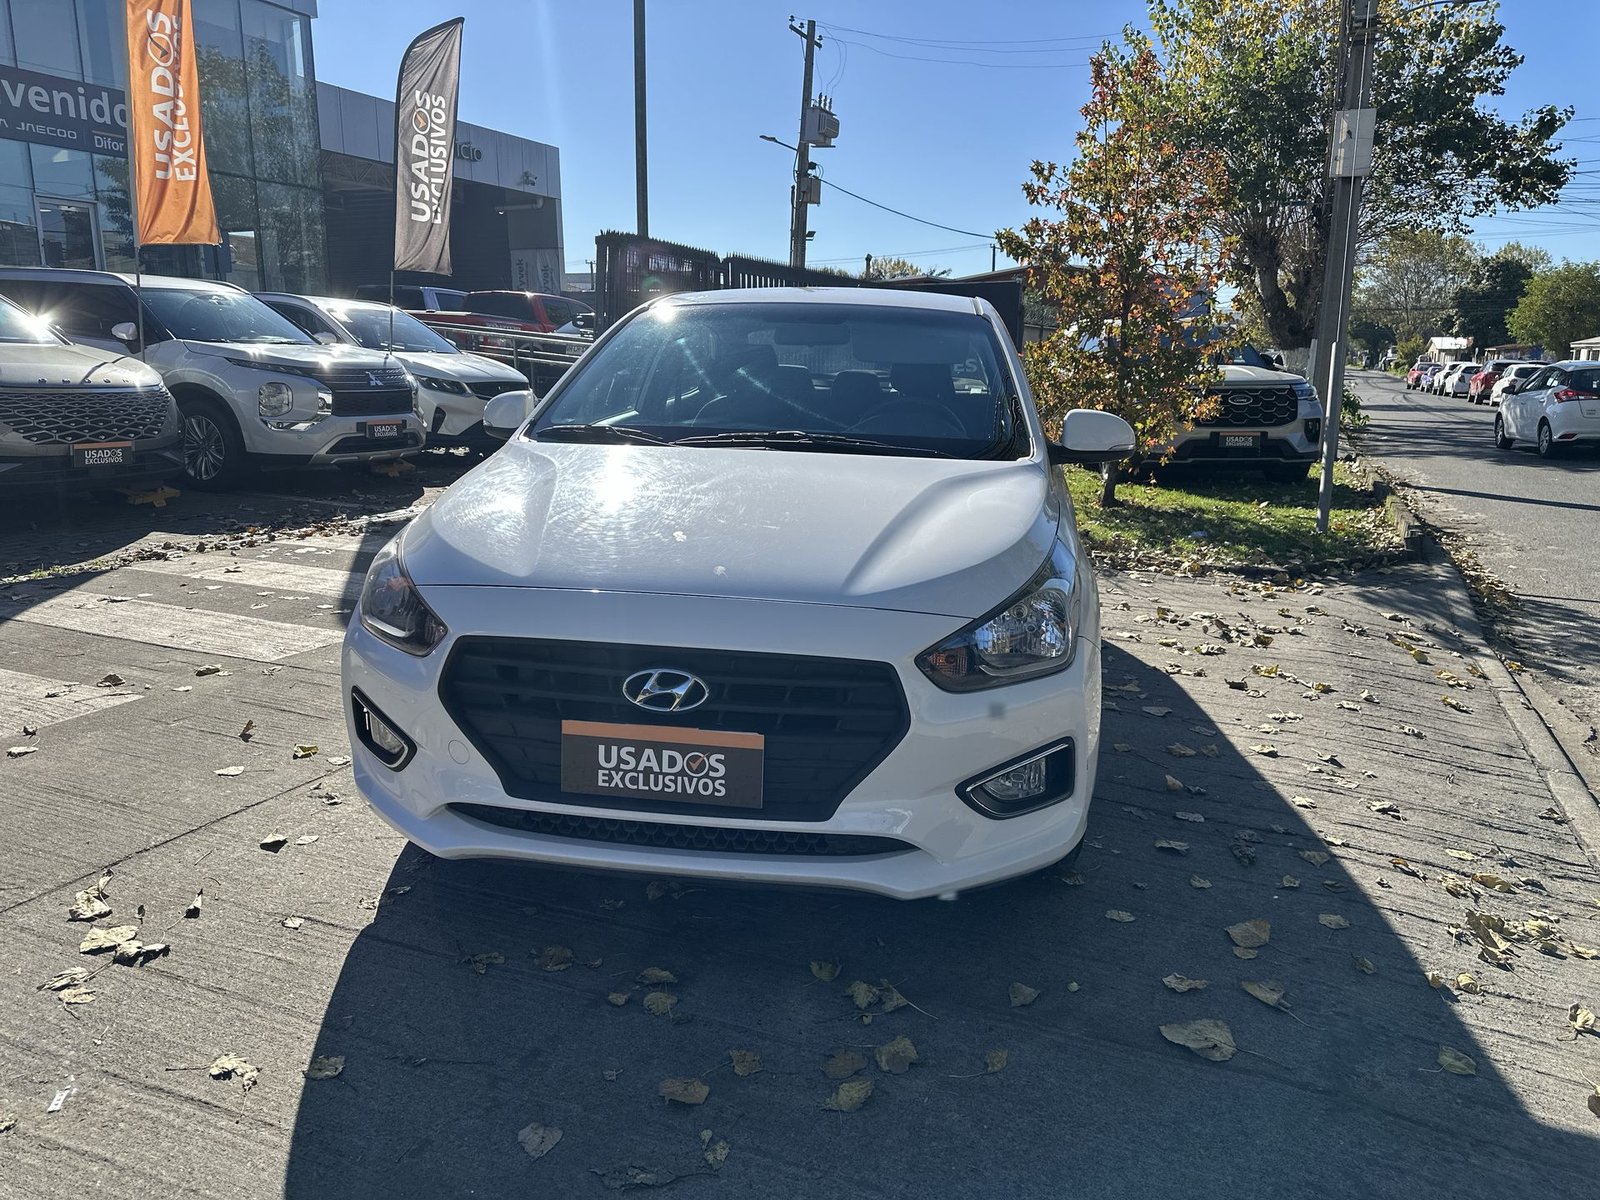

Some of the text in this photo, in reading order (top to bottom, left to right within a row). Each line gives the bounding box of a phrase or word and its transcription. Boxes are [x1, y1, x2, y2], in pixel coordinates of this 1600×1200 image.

[146, 8, 174, 180] USADOS
[172, 15, 197, 181] EXCLU
[16, 122, 77, 139] JAECOO
[94, 135, 125, 152] Difor
[411, 90, 431, 222] USADOS
[84, 449, 123, 459] USADOS
[85, 456, 123, 465] EXCLUSIVOS
[598, 744, 726, 777] USADOS
[597, 769, 726, 797] EXCLUSIVOS
